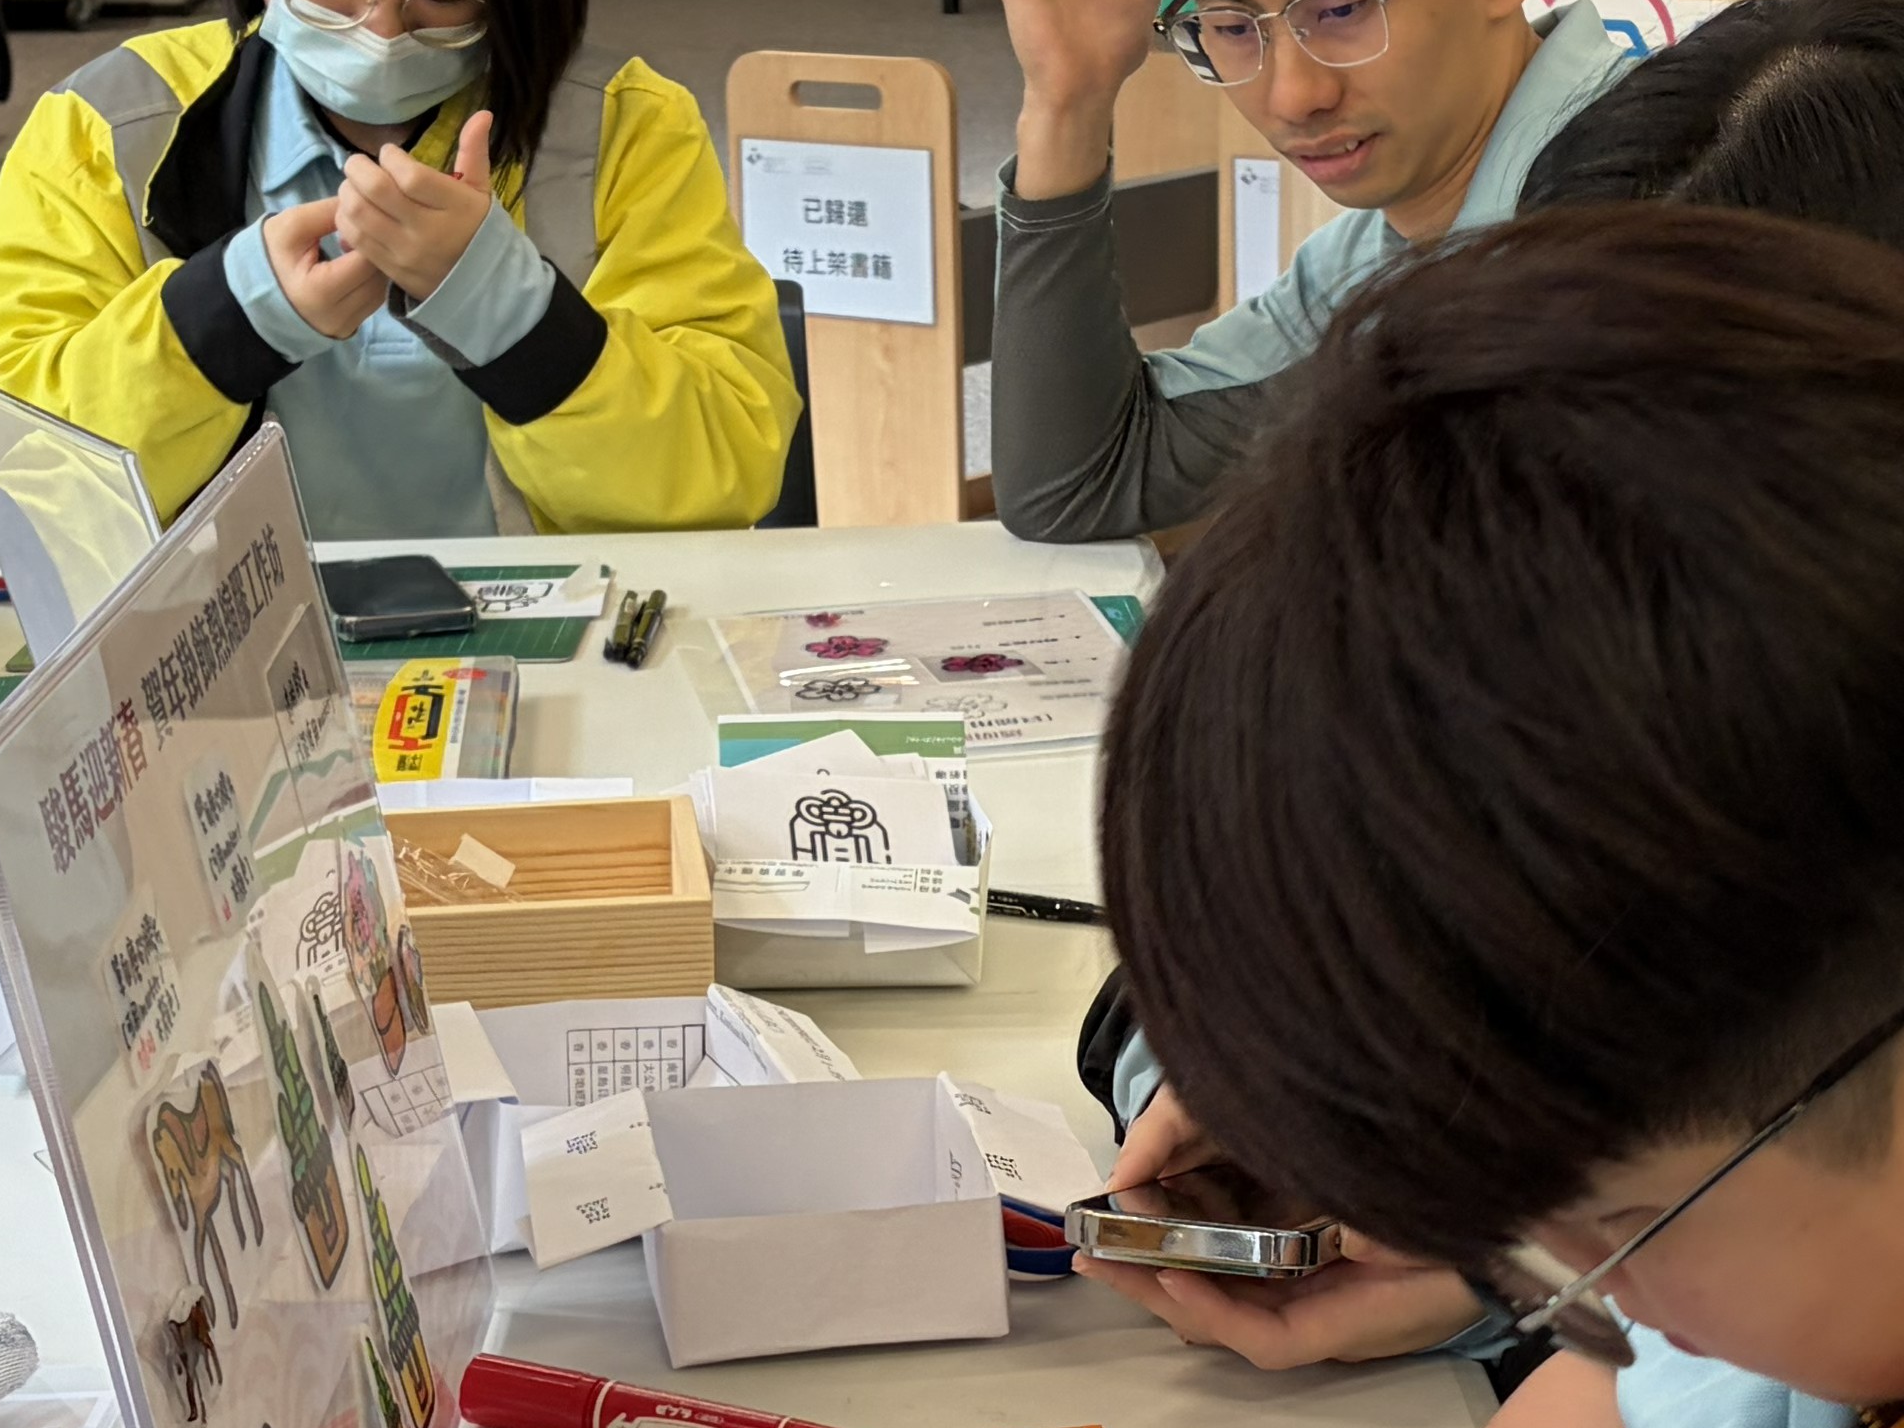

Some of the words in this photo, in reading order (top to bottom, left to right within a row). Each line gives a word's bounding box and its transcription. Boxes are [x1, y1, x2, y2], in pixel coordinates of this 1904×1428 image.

[802, 197, 869, 227] 已歸還
[783, 248, 893, 280] 待上架書籍
[38, 698, 149, 875] 駿馬迎新春
[140, 522, 286, 753] 賀年掛飾熱縮膠工作坊
